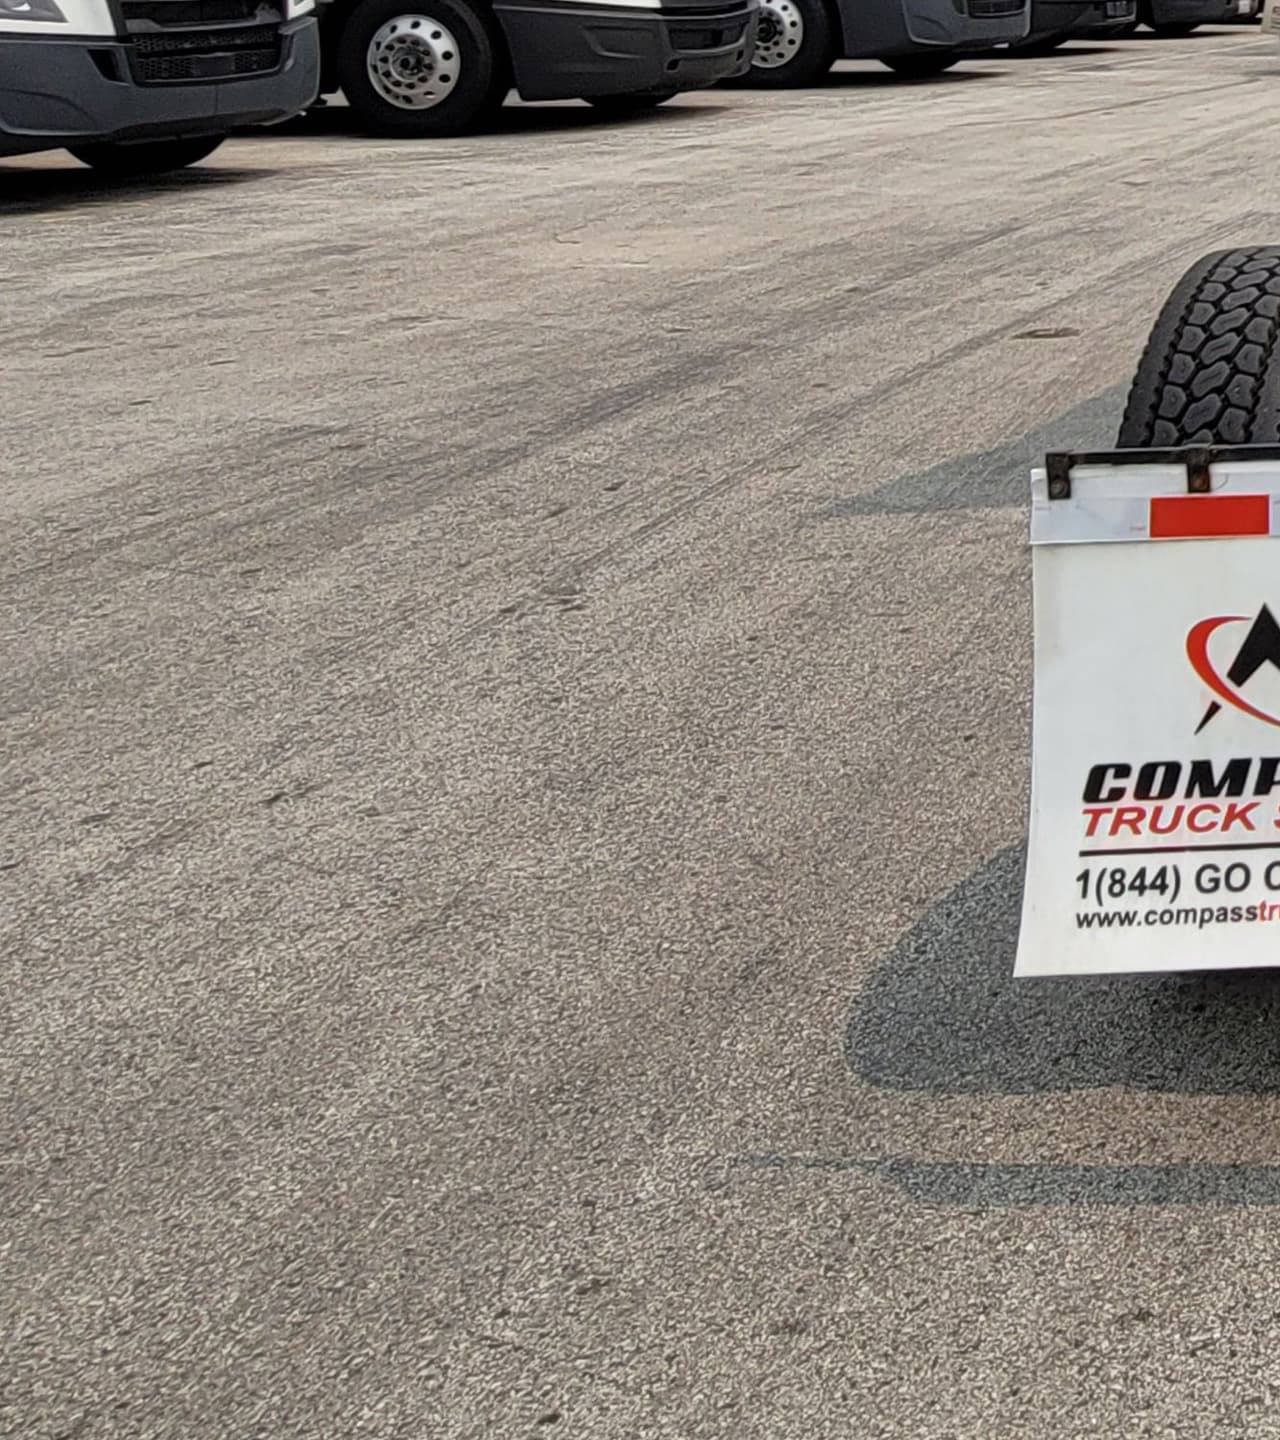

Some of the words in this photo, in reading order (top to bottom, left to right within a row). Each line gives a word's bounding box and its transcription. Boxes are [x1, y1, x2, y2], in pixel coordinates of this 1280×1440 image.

[1082, 799, 1256, 838] TRUCK
[1076, 863, 1181, 905] 1(844)
[1195, 861, 1252, 893] GO
